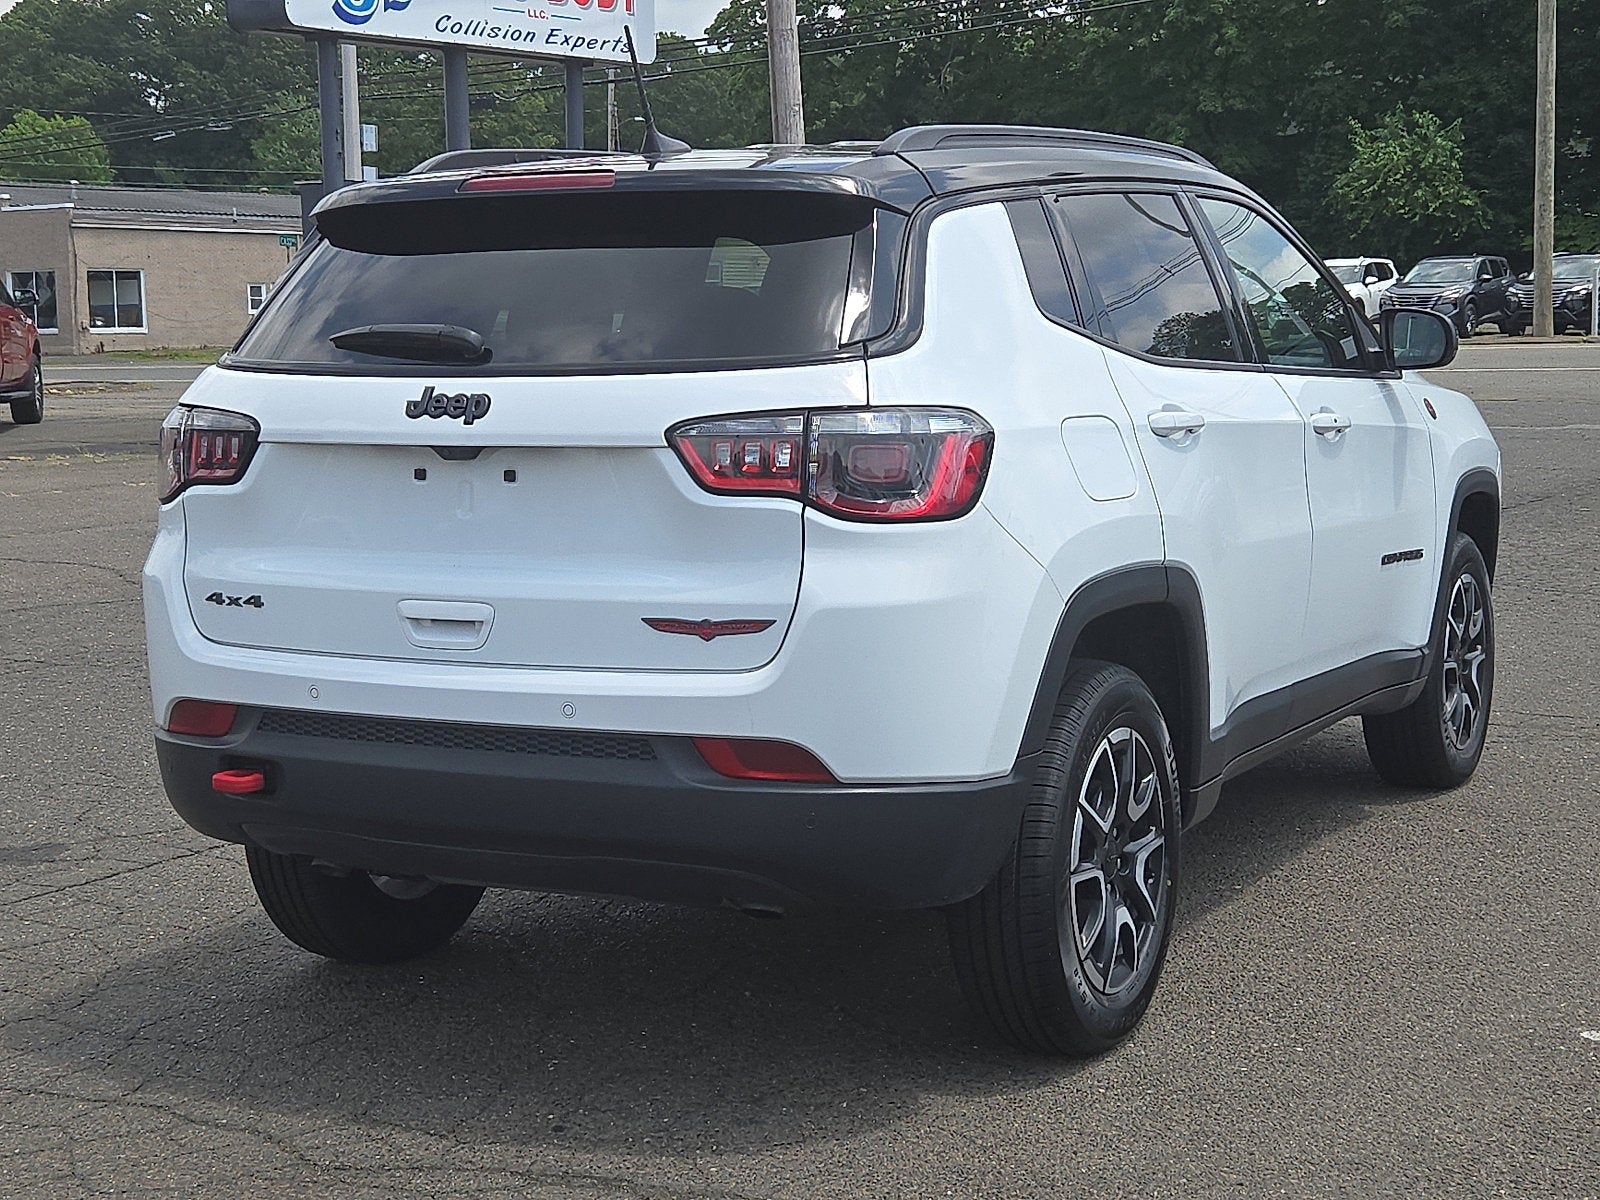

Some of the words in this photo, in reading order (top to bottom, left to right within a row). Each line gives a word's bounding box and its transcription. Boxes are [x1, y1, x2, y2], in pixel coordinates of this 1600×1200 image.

[527, 8, 549, 20] LLC.
[435, 14, 537, 43] Collision
[544, 28, 633, 54] Experts
[405, 386, 491, 425] Jeep
[204, 591, 265, 609] 4x4
